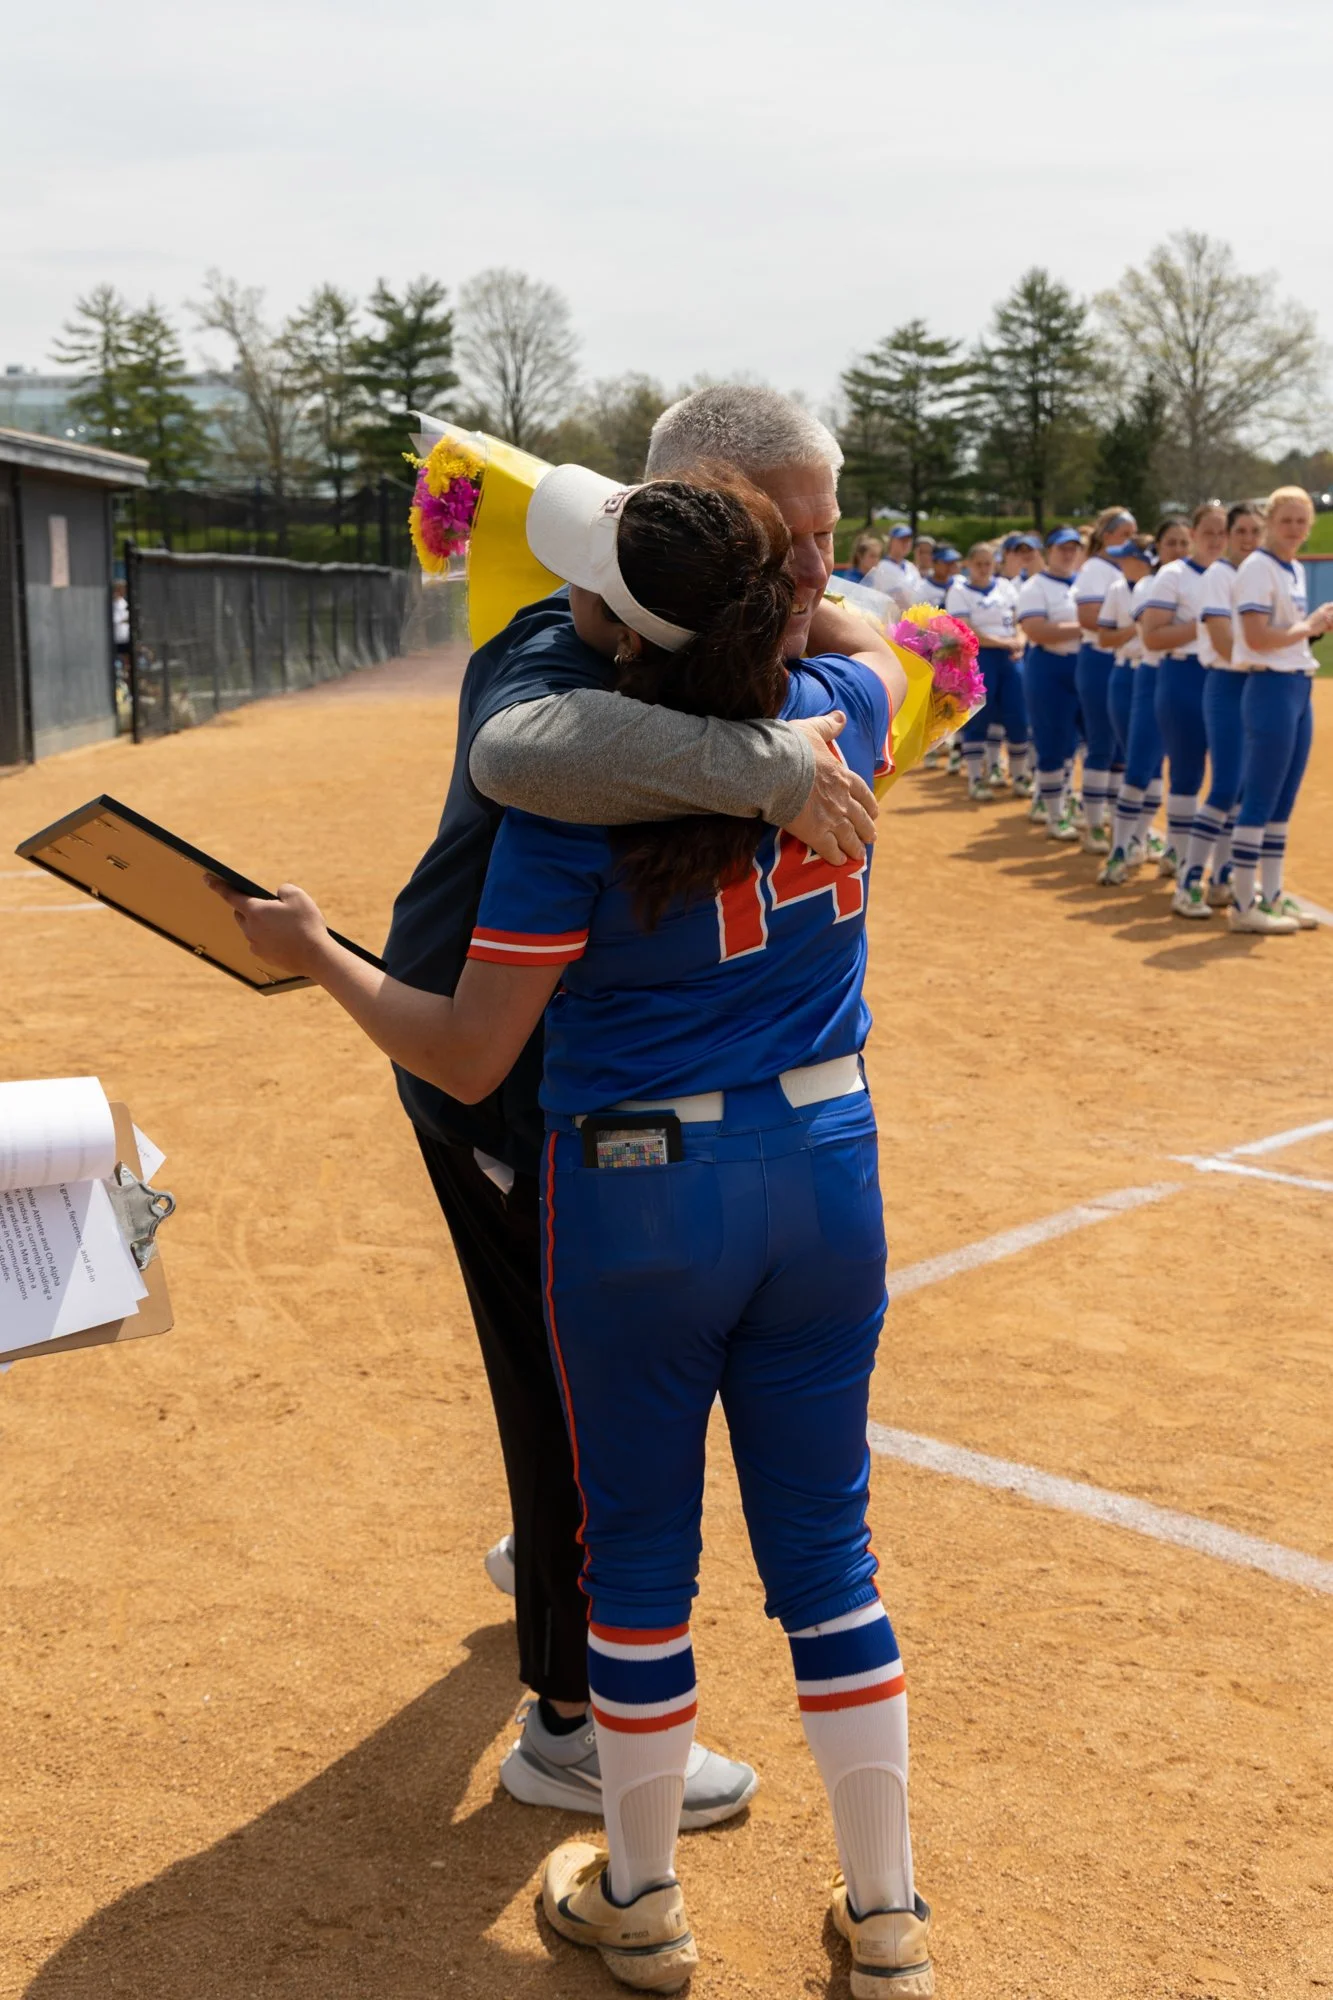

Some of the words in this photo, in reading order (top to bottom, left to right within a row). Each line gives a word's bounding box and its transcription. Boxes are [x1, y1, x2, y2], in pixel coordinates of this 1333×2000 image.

[3, 1191, 14, 1205] will
[60, 1188, 72, 1210] grace,
[6, 1206, 22, 1239] graduate
[32, 1208, 45, 1236] Athlete
[3, 1230, 10, 1238] in
[17, 1197, 30, 1225] Lindsay
[27, 1233, 42, 1266] currently
[38, 1266, 51, 1295] holding
[18, 1240, 25, 1248] in
[40, 1237, 52, 1252] and
[20, 1248, 30, 1265] May
[45, 1252, 54, 1265] Chi
[81, 1249, 91, 1264] and
[5, 1238, 28, 1301] Communications
[25, 1265, 36, 1283] with
[49, 1265, 61, 1287] Alpha
[85, 1264, 96, 1283] all-in
